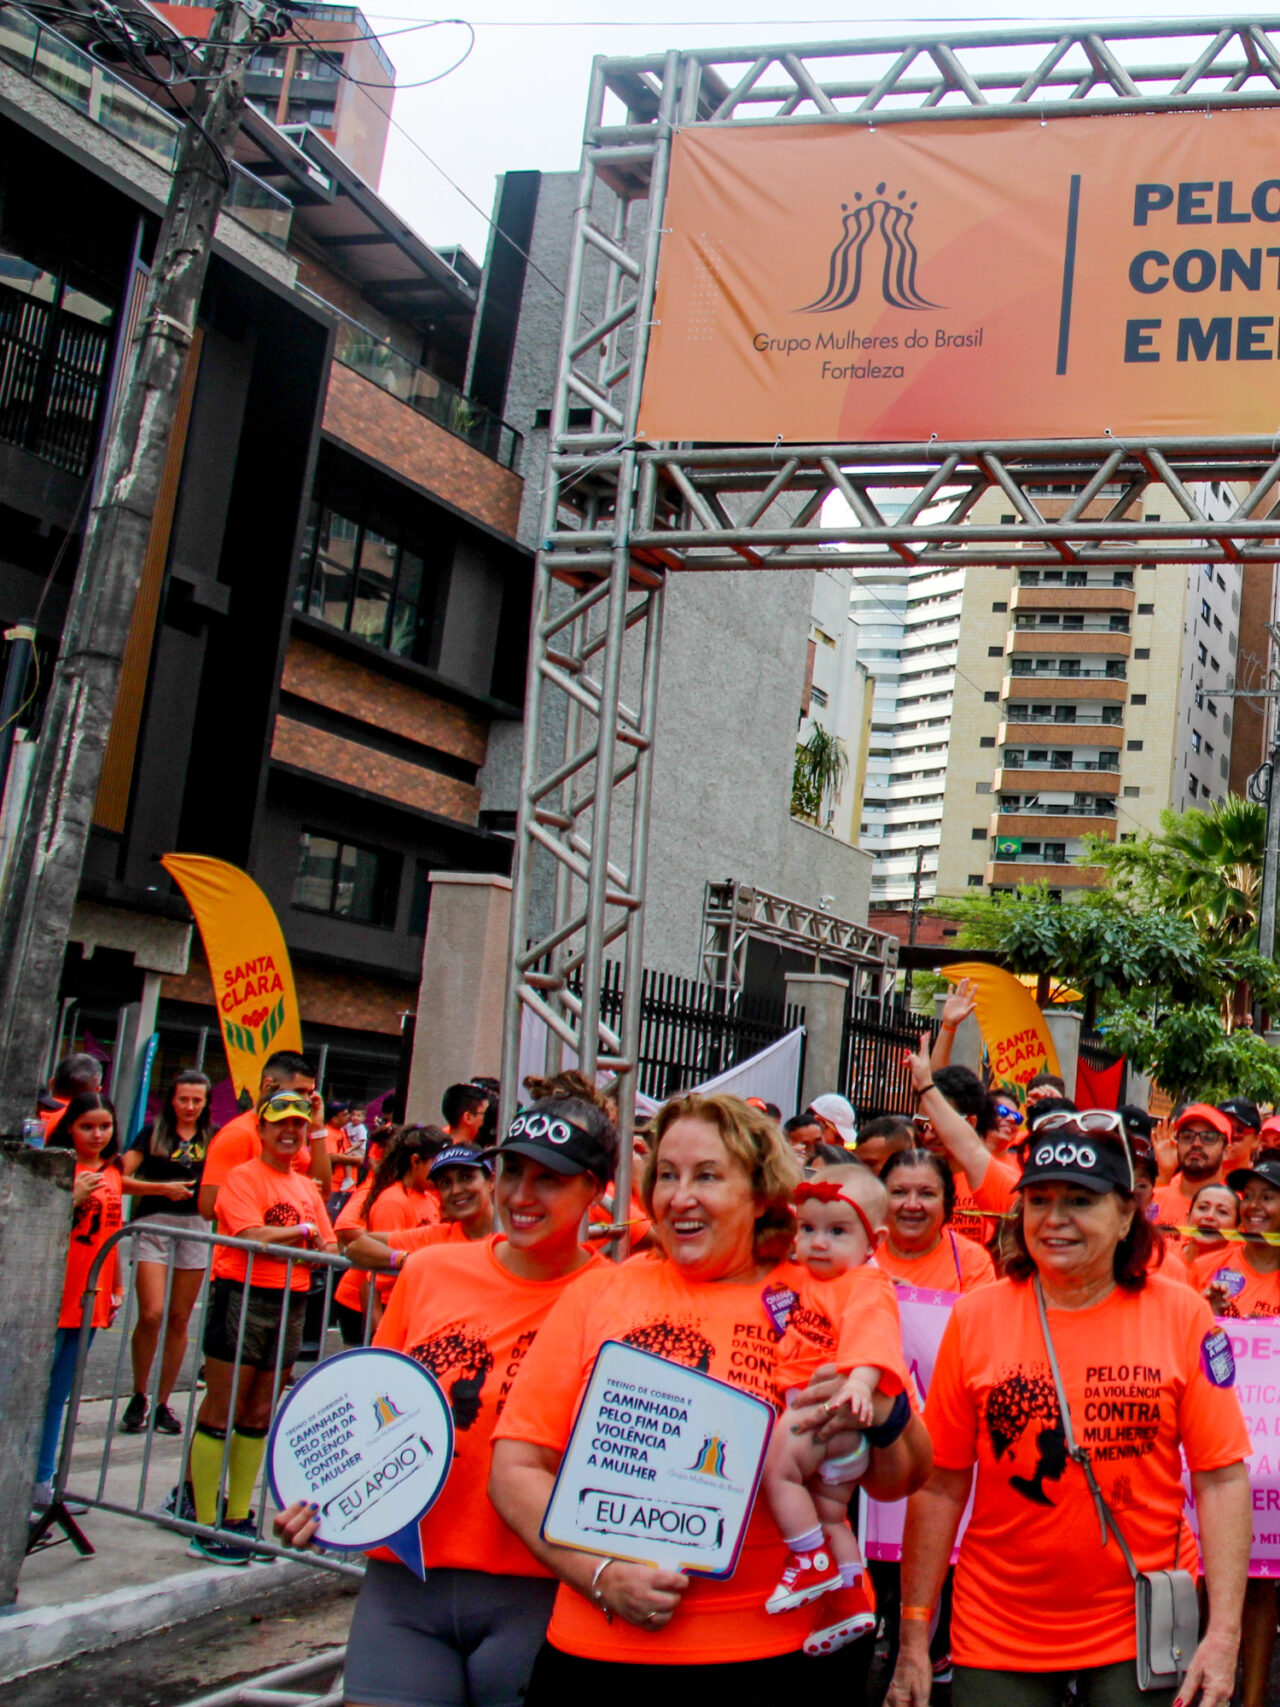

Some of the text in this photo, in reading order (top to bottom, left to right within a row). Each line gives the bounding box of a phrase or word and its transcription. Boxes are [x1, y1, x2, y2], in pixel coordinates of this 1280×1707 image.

[753, 327, 983, 356] Grupo Mulheres do Brasil
[1123, 319, 1162, 363] E
[821, 359, 904, 380] Fortaleza
[224, 956, 275, 988] SANTA
[221, 973, 284, 1013] CLARA
[996, 1028, 1039, 1056] SANTA
[995, 1042, 1047, 1075] CLARA
[1086, 1366, 1161, 1383] PELO FIM
[602, 1390, 688, 1423] CAMINHADA
[607, 1378, 636, 1392] TREINO
[638, 1386, 649, 1395] DE
[650, 1390, 686, 1405] CORRIDA
[1085, 1384, 1160, 1399] DA VIOLÊNCIA
[289, 1402, 355, 1448] CAMINHADA
[598, 1405, 681, 1438] PELO FIM DA
[1084, 1402, 1161, 1422] CONTRA
[294, 1414, 358, 1460] PELO FIM DA
[596, 1421, 667, 1451] VIOLÊNCIA
[1083, 1426, 1159, 1442] MULHERES
[299, 1430, 354, 1469] VIOLÊNCIA
[304, 1447, 350, 1480] CONTRA
[591, 1438, 649, 1463] CONTRA
[1094, 1442, 1155, 1462] MENINAS
[1256, 1454, 1272, 1475] A
[311, 1452, 363, 1492] A MULHER
[338, 1448, 417, 1516] EU APOIO
[586, 1454, 657, 1482] A MULHER
[1252, 1489, 1280, 1511] ER
[596, 1500, 706, 1537] EU APOIO
